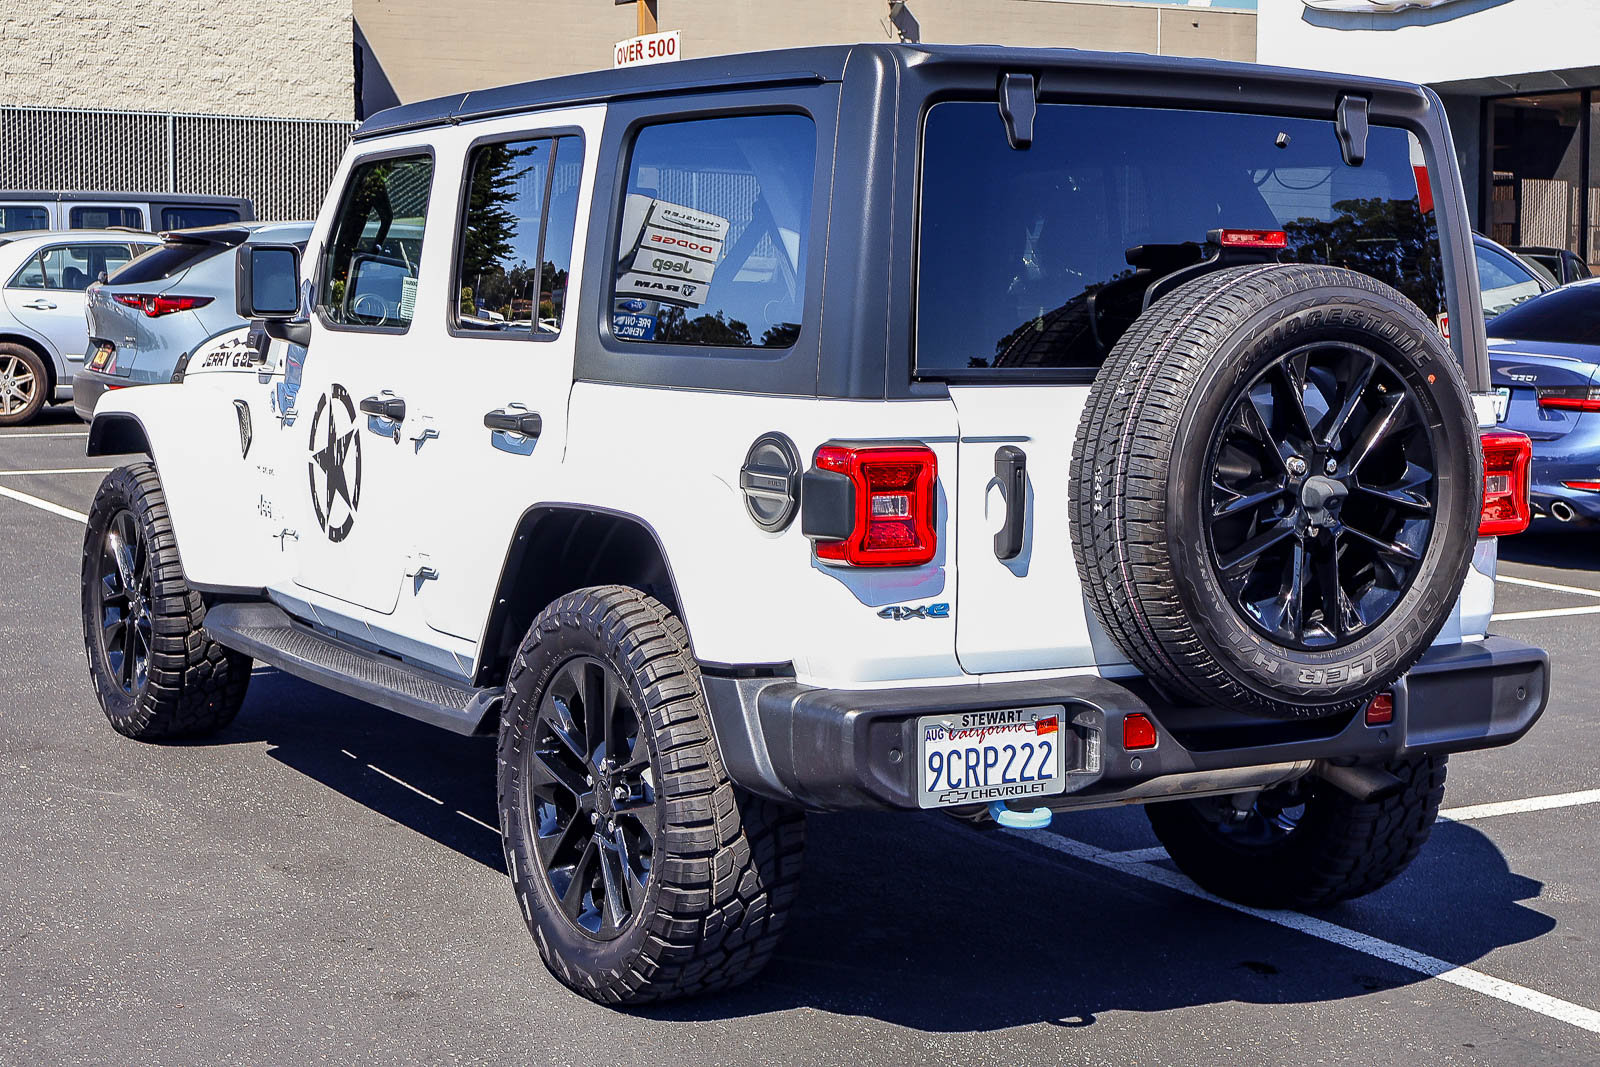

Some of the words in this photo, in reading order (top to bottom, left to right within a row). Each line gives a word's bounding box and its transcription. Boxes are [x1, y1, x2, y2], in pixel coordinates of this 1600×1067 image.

[617, 43, 643, 65] OVER
[648, 37, 675, 58] 500
[202, 351, 232, 368] JERRY
[1233, 308, 1432, 384] BRIDGESTONE
[1225, 618, 1280, 674] H/L
[1297, 586, 1440, 685] DUELER
[961, 710, 1024, 727] STEWART
[925, 729, 944, 742] AUG
[948, 722, 1036, 744] California
[928, 740, 1053, 792] 9CRP222
[971, 782, 1047, 800] CHEVROLET
